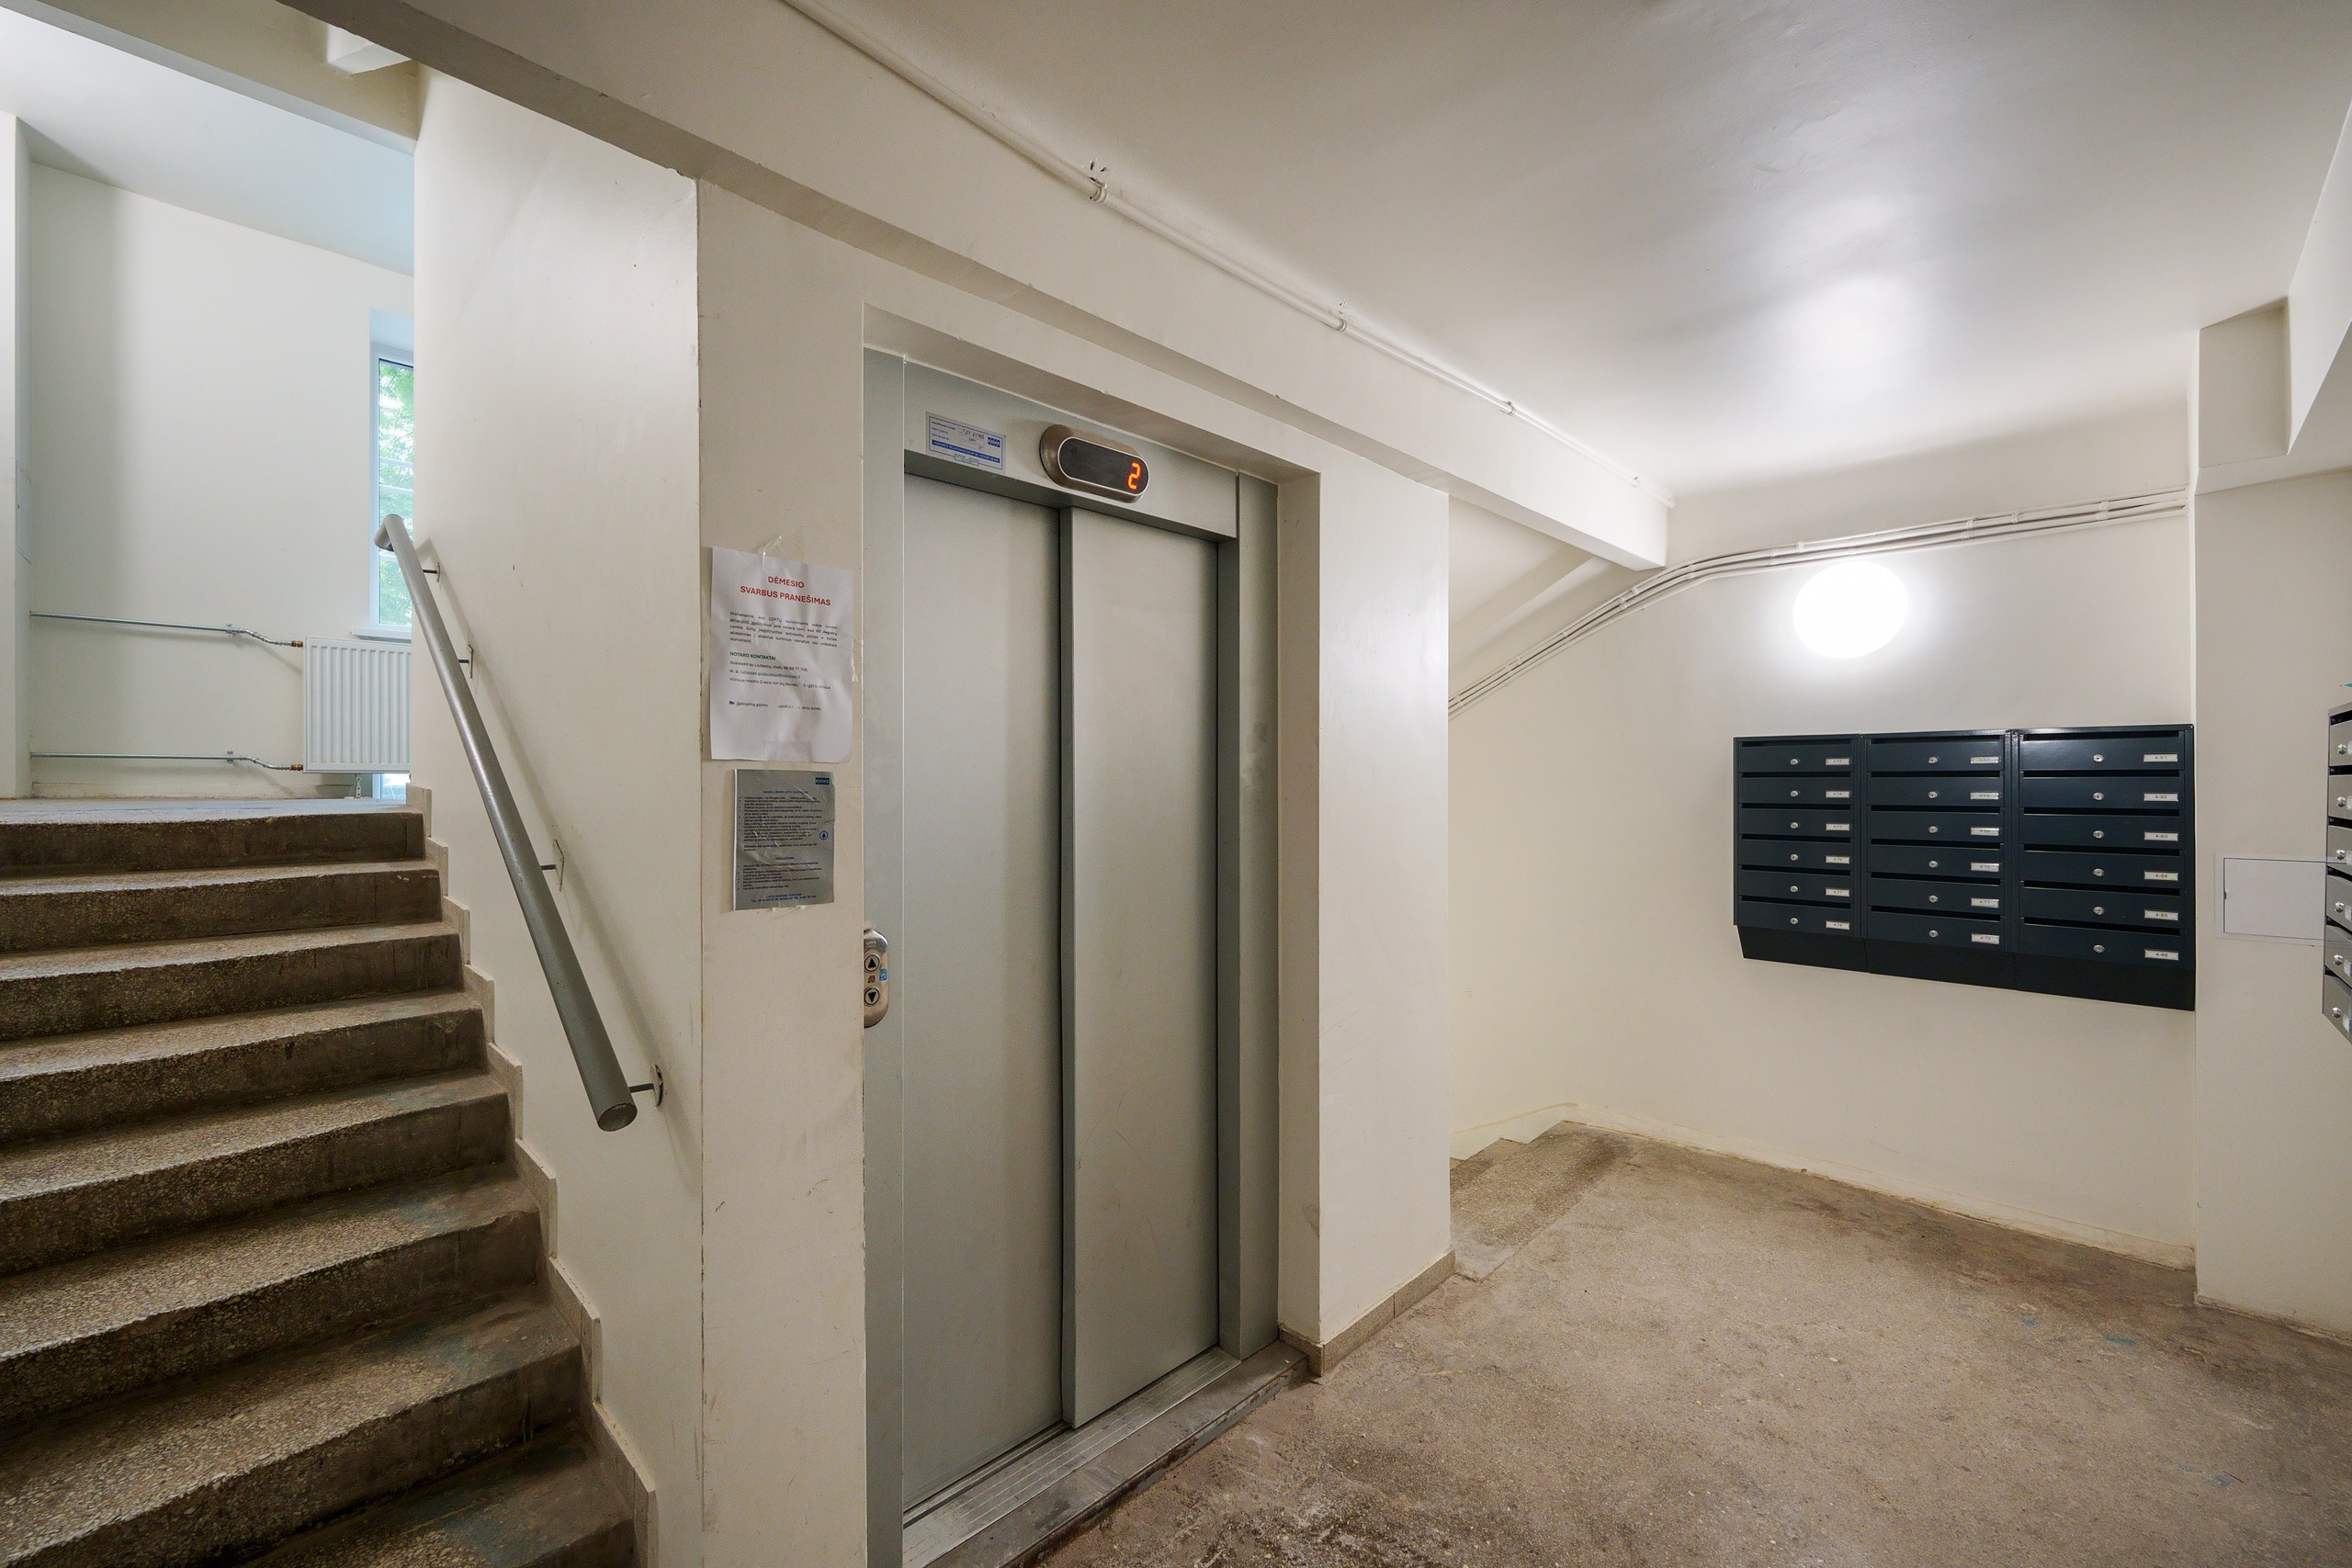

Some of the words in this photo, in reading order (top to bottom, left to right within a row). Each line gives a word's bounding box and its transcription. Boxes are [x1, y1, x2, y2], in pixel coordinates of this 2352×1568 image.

[1128, 462, 1141, 490] 2
[768, 576, 804, 588] DĖMESIO
[741, 586, 778, 598] SVARBUS
[780, 592, 831, 606] PRANEŠIMAS
